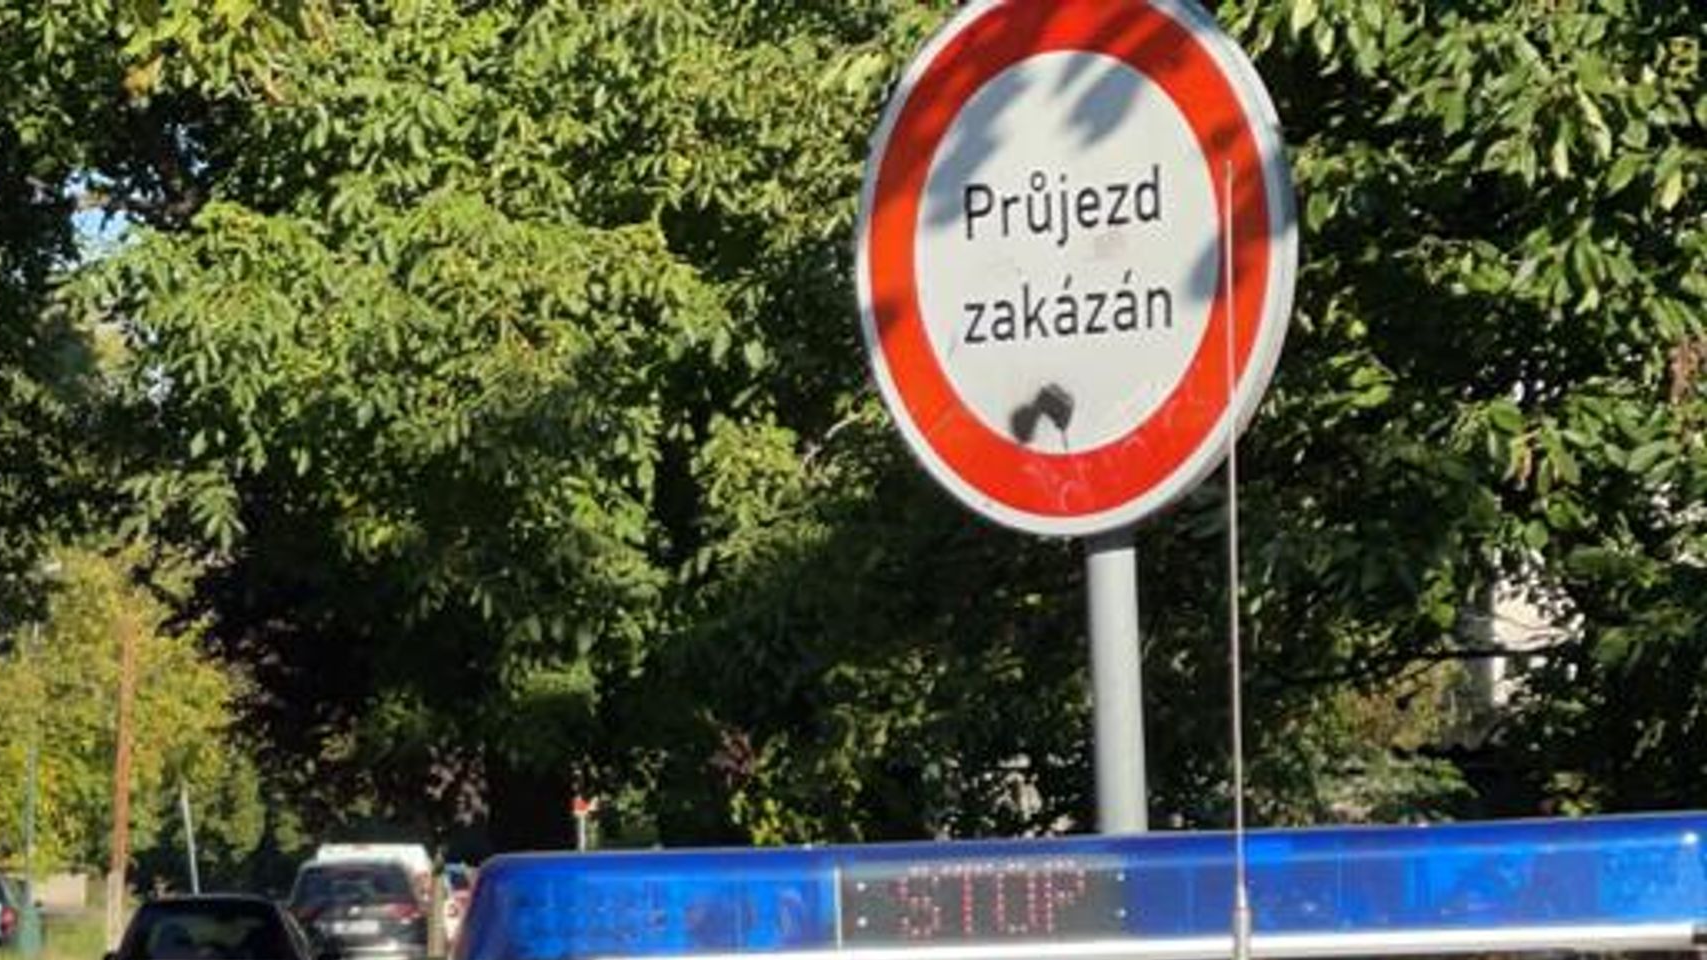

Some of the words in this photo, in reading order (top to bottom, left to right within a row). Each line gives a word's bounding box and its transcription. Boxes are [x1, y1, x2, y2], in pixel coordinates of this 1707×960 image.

[964, 163, 1161, 248] Průjezd
[963, 268, 1173, 344] zakázán
[894, 859, 1086, 939] STOP
